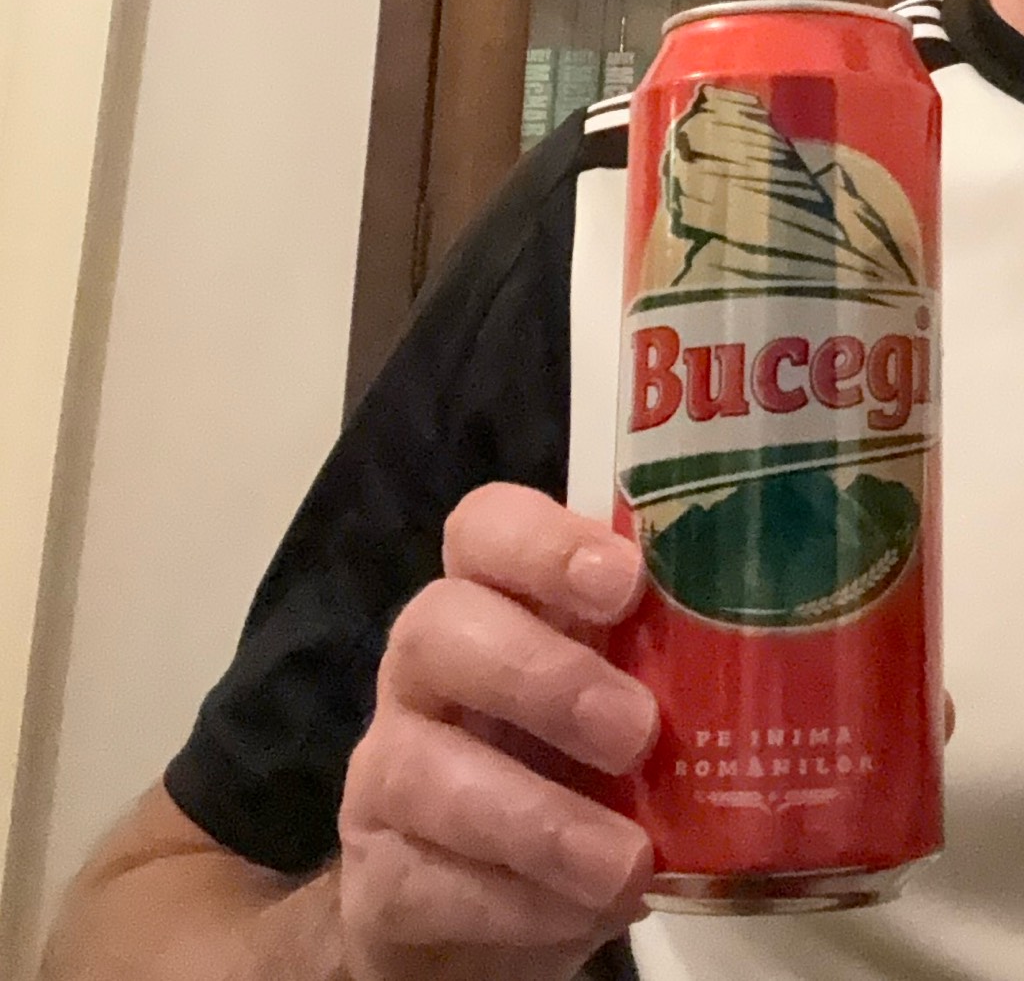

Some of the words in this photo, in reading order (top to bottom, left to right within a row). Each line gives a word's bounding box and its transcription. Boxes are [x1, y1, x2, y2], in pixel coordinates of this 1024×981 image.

[628, 305, 932, 433] Bucegi
[695, 730, 731, 747] PE
[750, 726, 851, 747] INIMA
